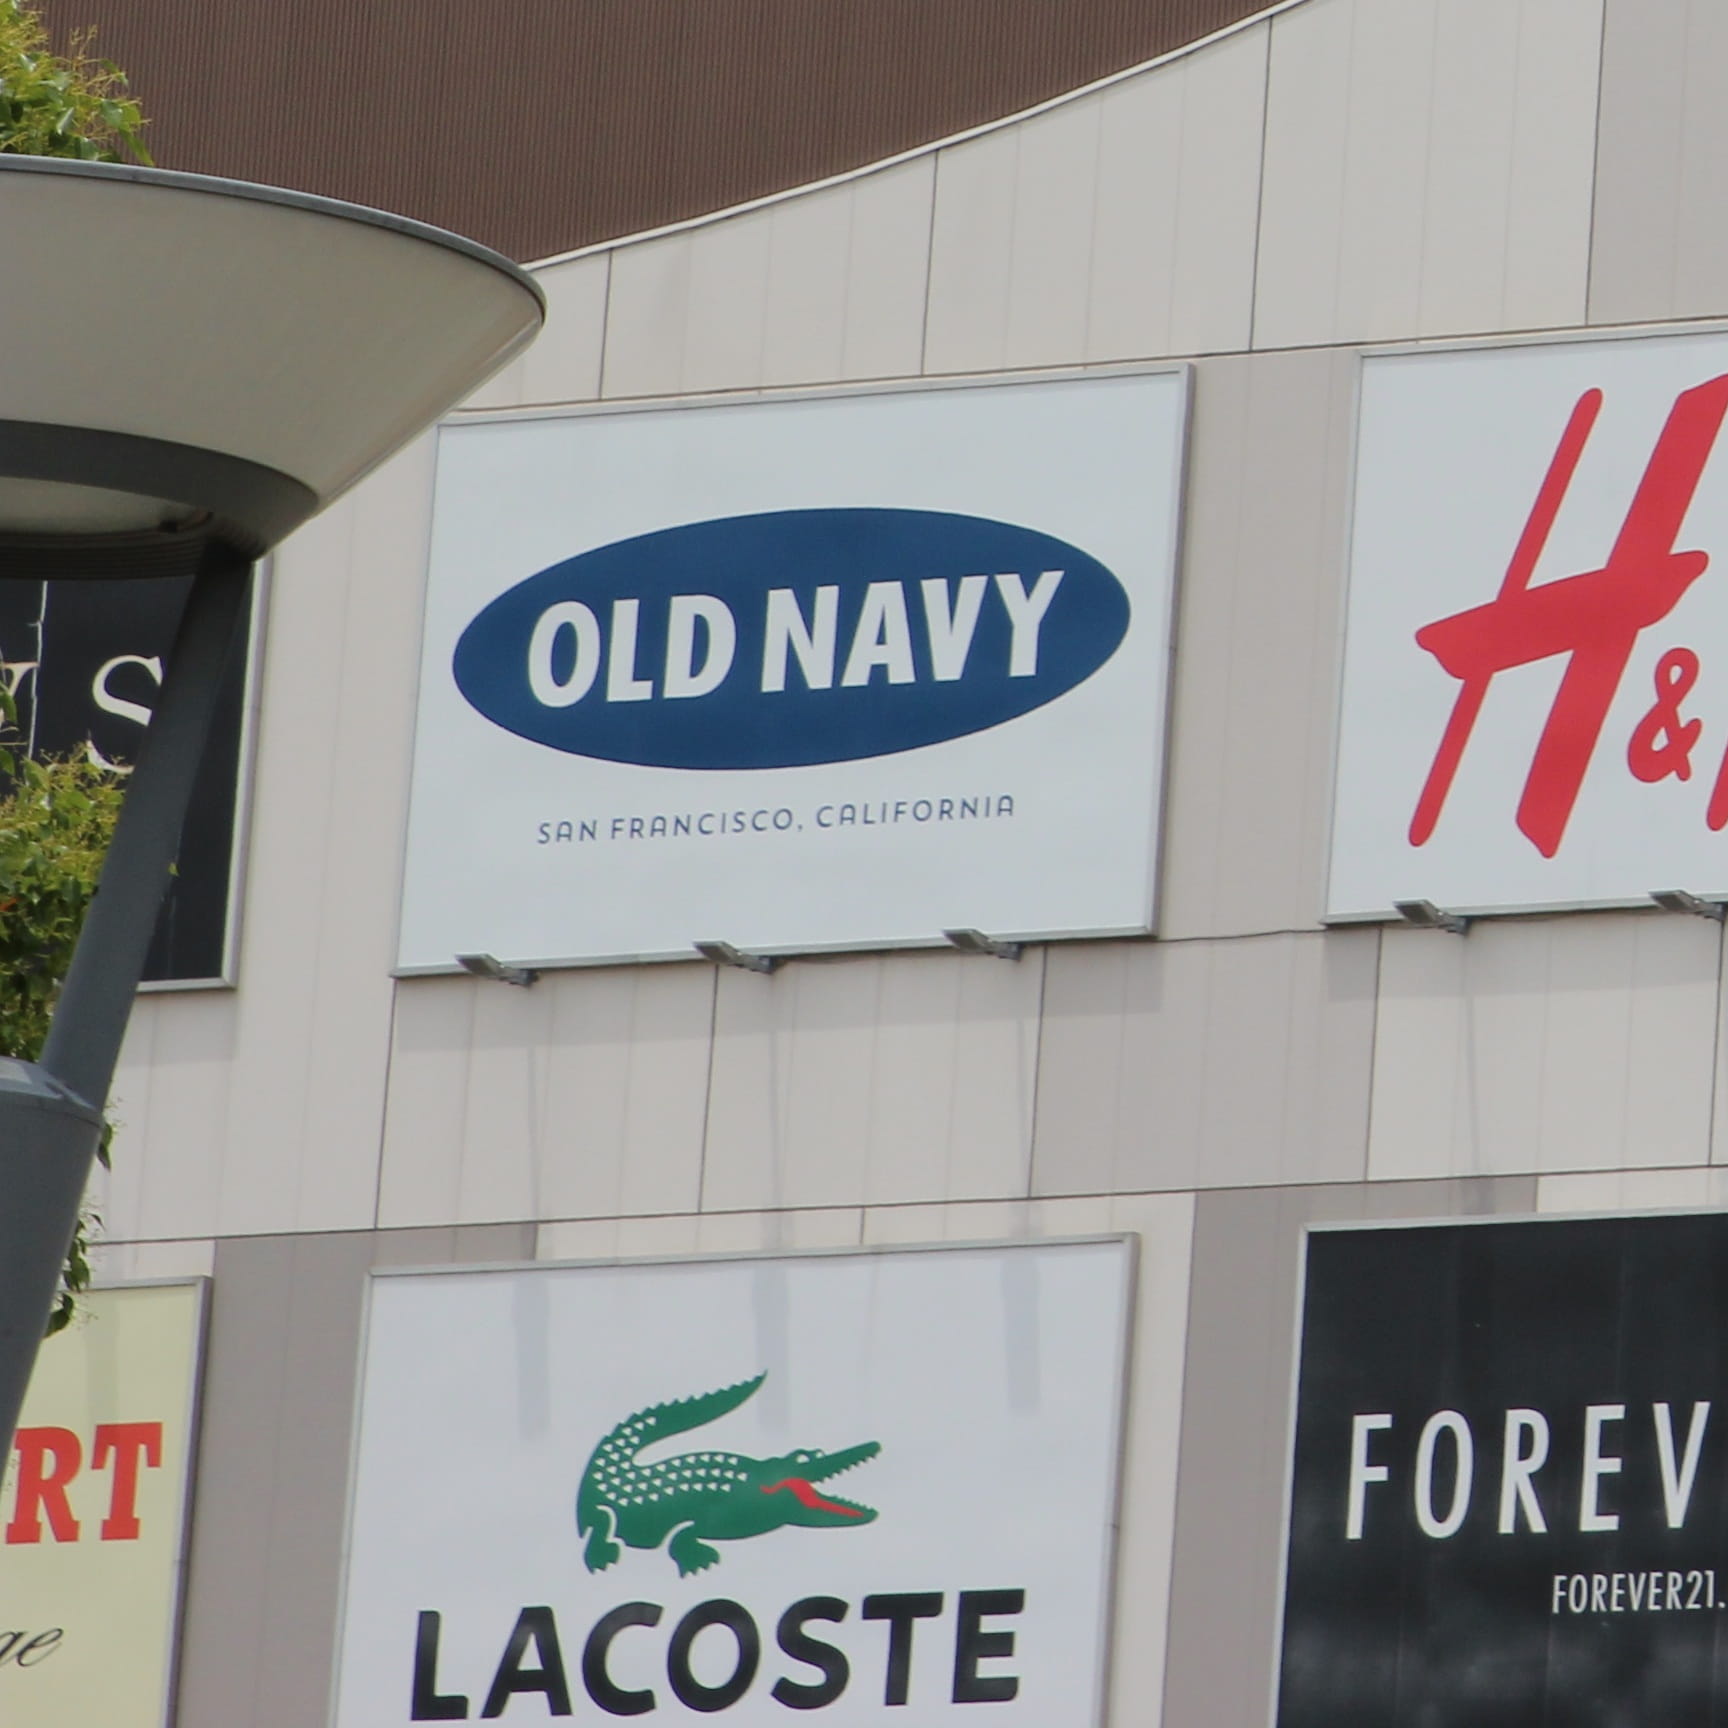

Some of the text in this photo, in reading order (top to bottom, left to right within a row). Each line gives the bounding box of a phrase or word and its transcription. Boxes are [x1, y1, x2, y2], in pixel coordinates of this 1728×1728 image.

[527, 569, 1065, 709] OLD NAVY
[536, 794, 1016, 844] SAN FRANCISCO, CALIFORNIA
[410, 1588, 1026, 1721] LACOSTE
